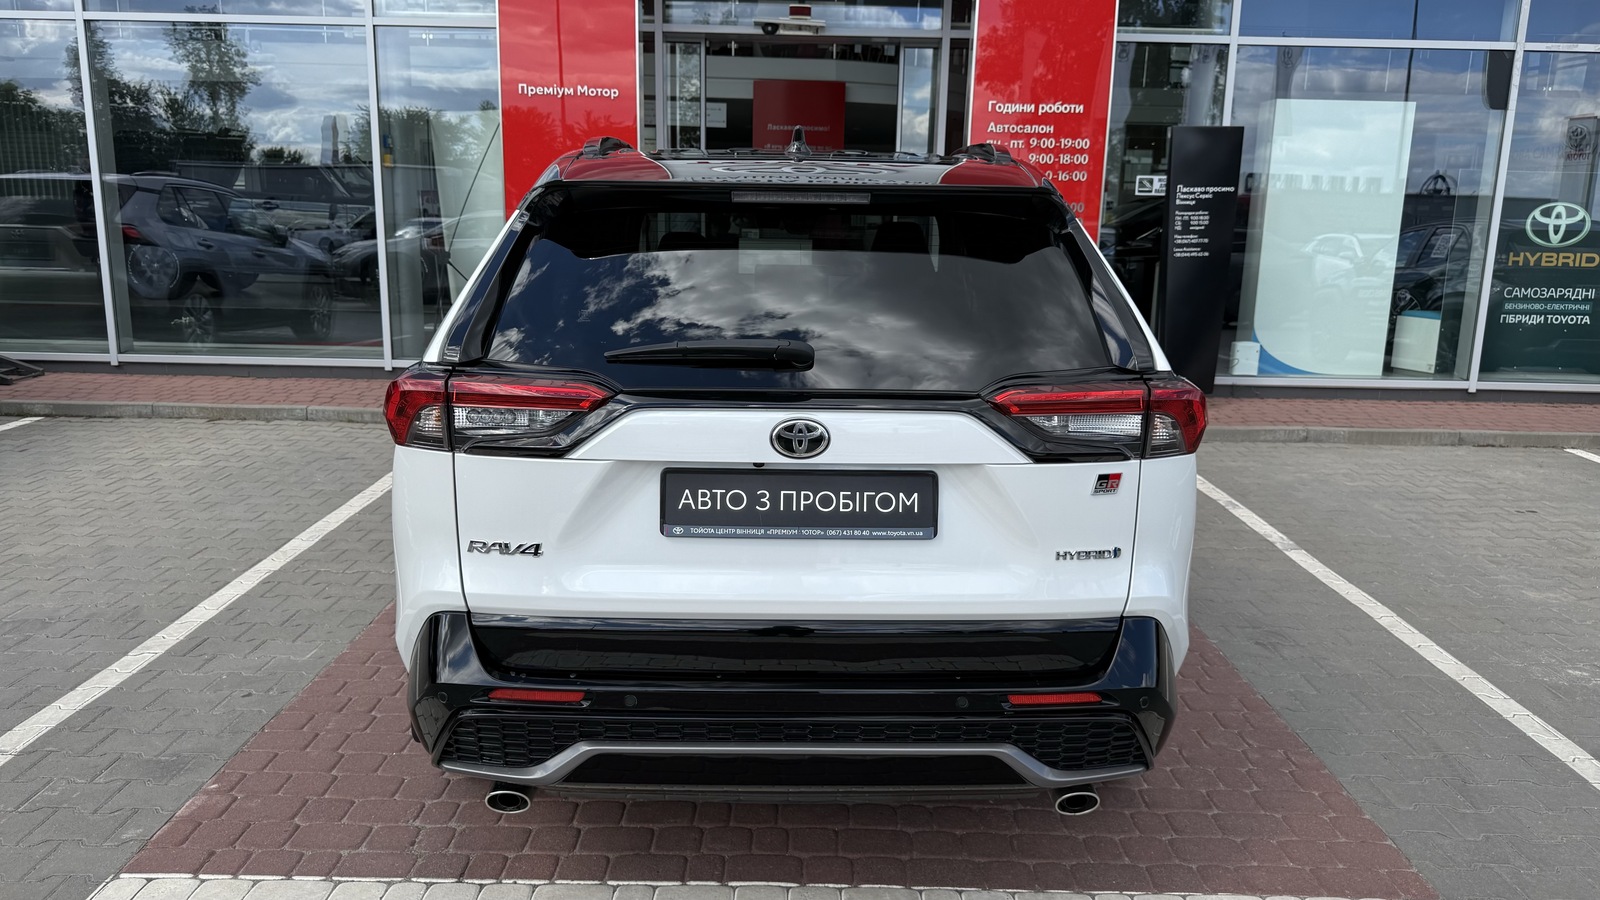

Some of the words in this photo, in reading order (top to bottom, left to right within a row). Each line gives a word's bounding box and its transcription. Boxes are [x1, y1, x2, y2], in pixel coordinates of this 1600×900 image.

[518, 83, 574, 98] Преміум
[577, 85, 620, 99] Мотор
[988, 100, 1035, 114] Години
[1038, 101, 1084, 115] роботи
[986, 122, 1054, 134] Автосалон
[1029, 138, 1090, 149] 9:00-19:00
[1028, 154, 1089, 165] 9:00-18:00
[1508, 252, 1600, 267] HYBRID
[1504, 287, 1596, 300] САМОЗАРЯДНІ
[1504, 302, 1590, 311] БЕНЗИНОВО-ЕЛЕКТРИЧНІ
[1500, 314, 1544, 326] ГІБРИДИ
[1546, 314, 1591, 325] TOYOTA
[1095, 480, 1119, 489] GR
[678, 488, 747, 510] АВТО
[755, 490, 770, 511] З
[780, 490, 919, 513] ПРОБІГОМ
[467, 539, 544, 558] RAV4
[1056, 550, 1112, 560] HYBRID
